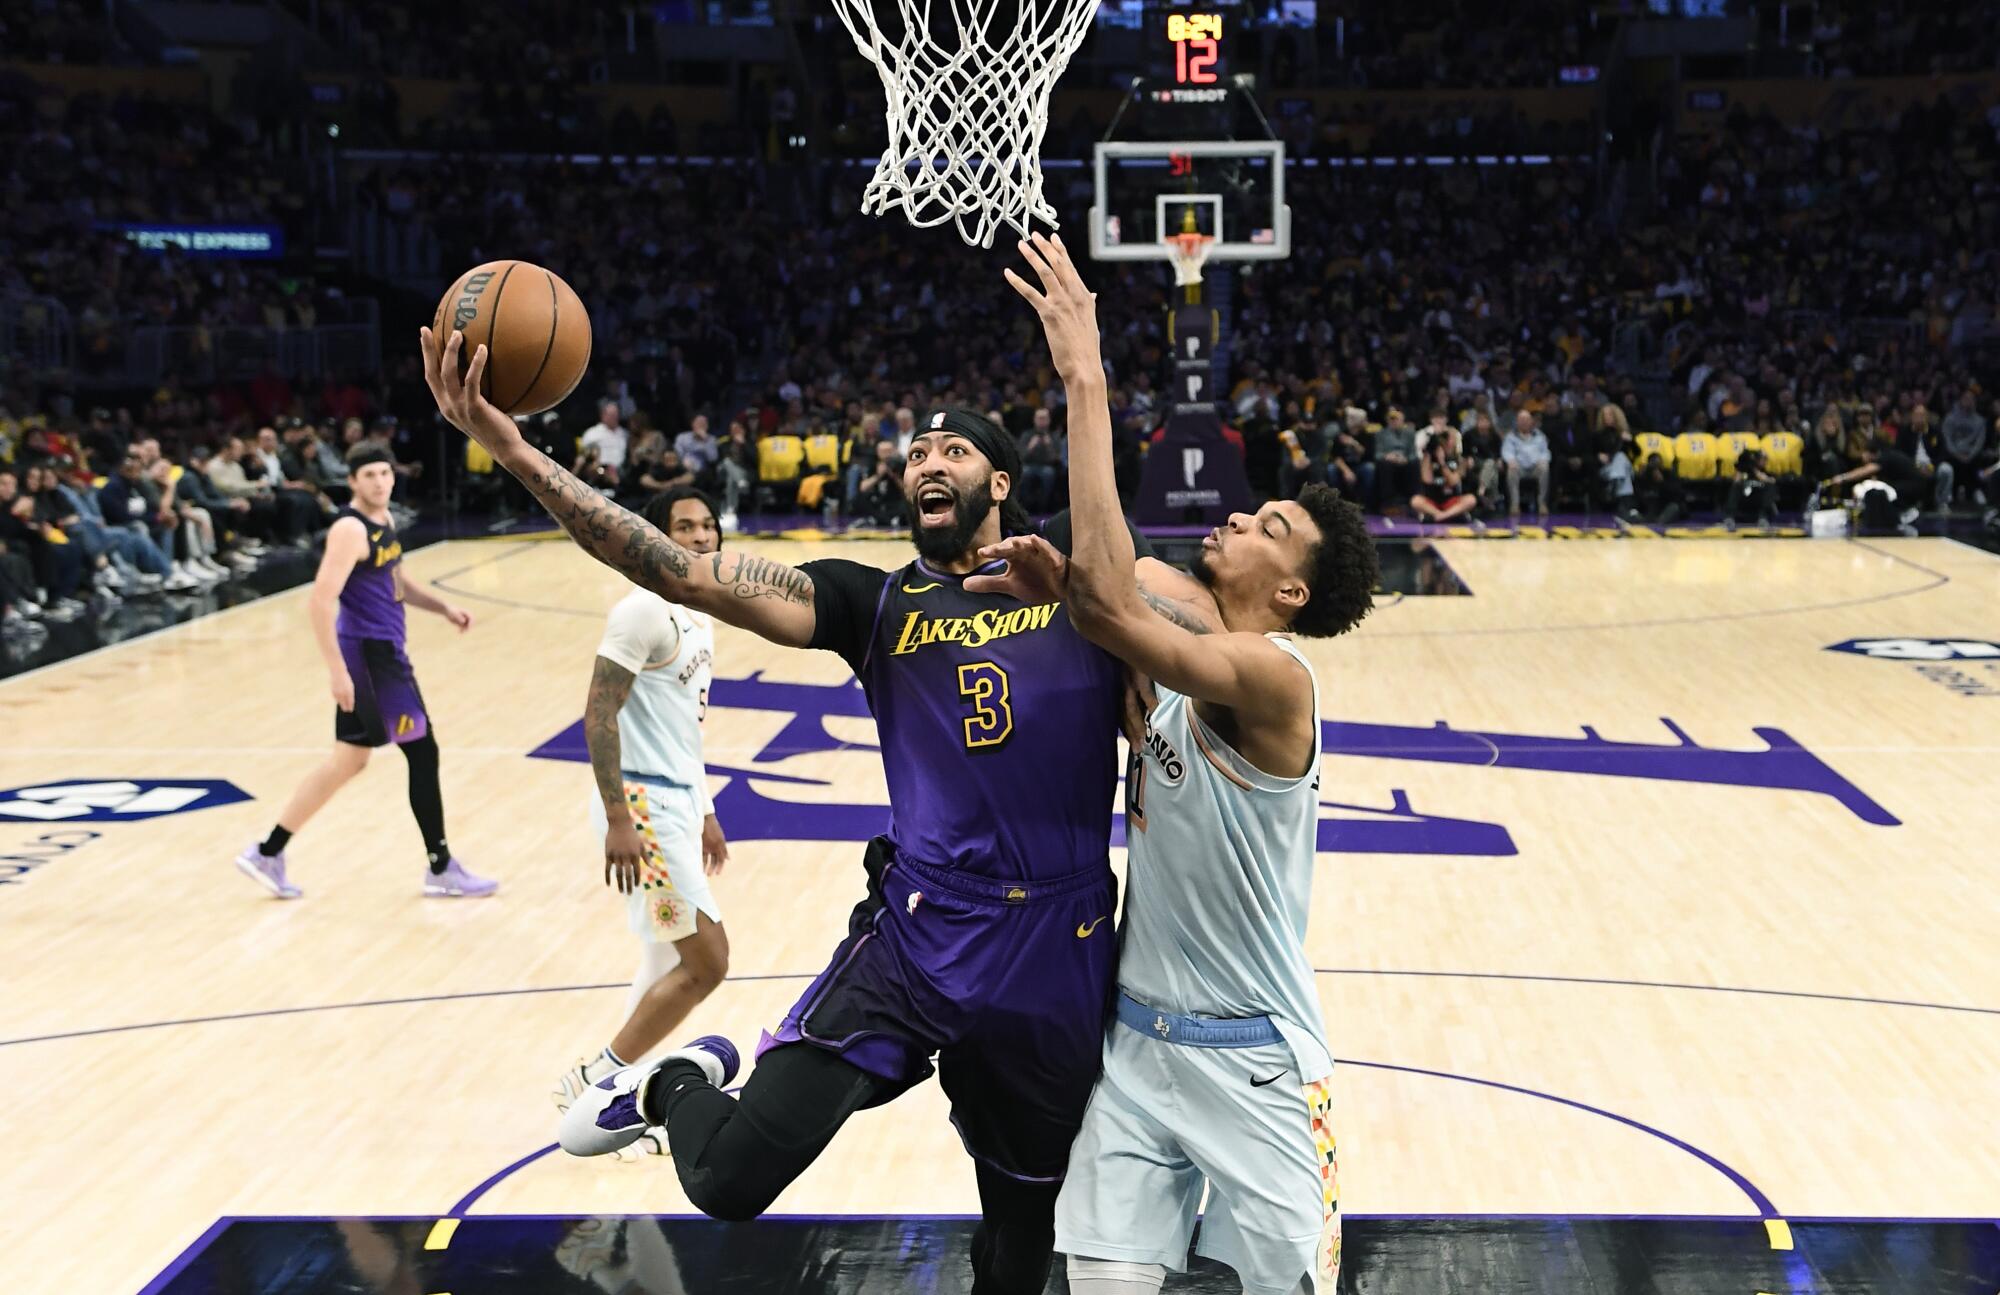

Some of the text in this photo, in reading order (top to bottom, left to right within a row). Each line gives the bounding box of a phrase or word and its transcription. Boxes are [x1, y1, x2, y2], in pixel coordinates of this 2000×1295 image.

[1167, 14, 1222, 41] 8:24
[1176, 38, 1217, 83] 12
[1171, 89, 1228, 102] TISSOT
[192, 232, 270, 250] EXPRESS
[957, 661, 1014, 750] 3
[1145, 711, 1186, 782] ONIO
